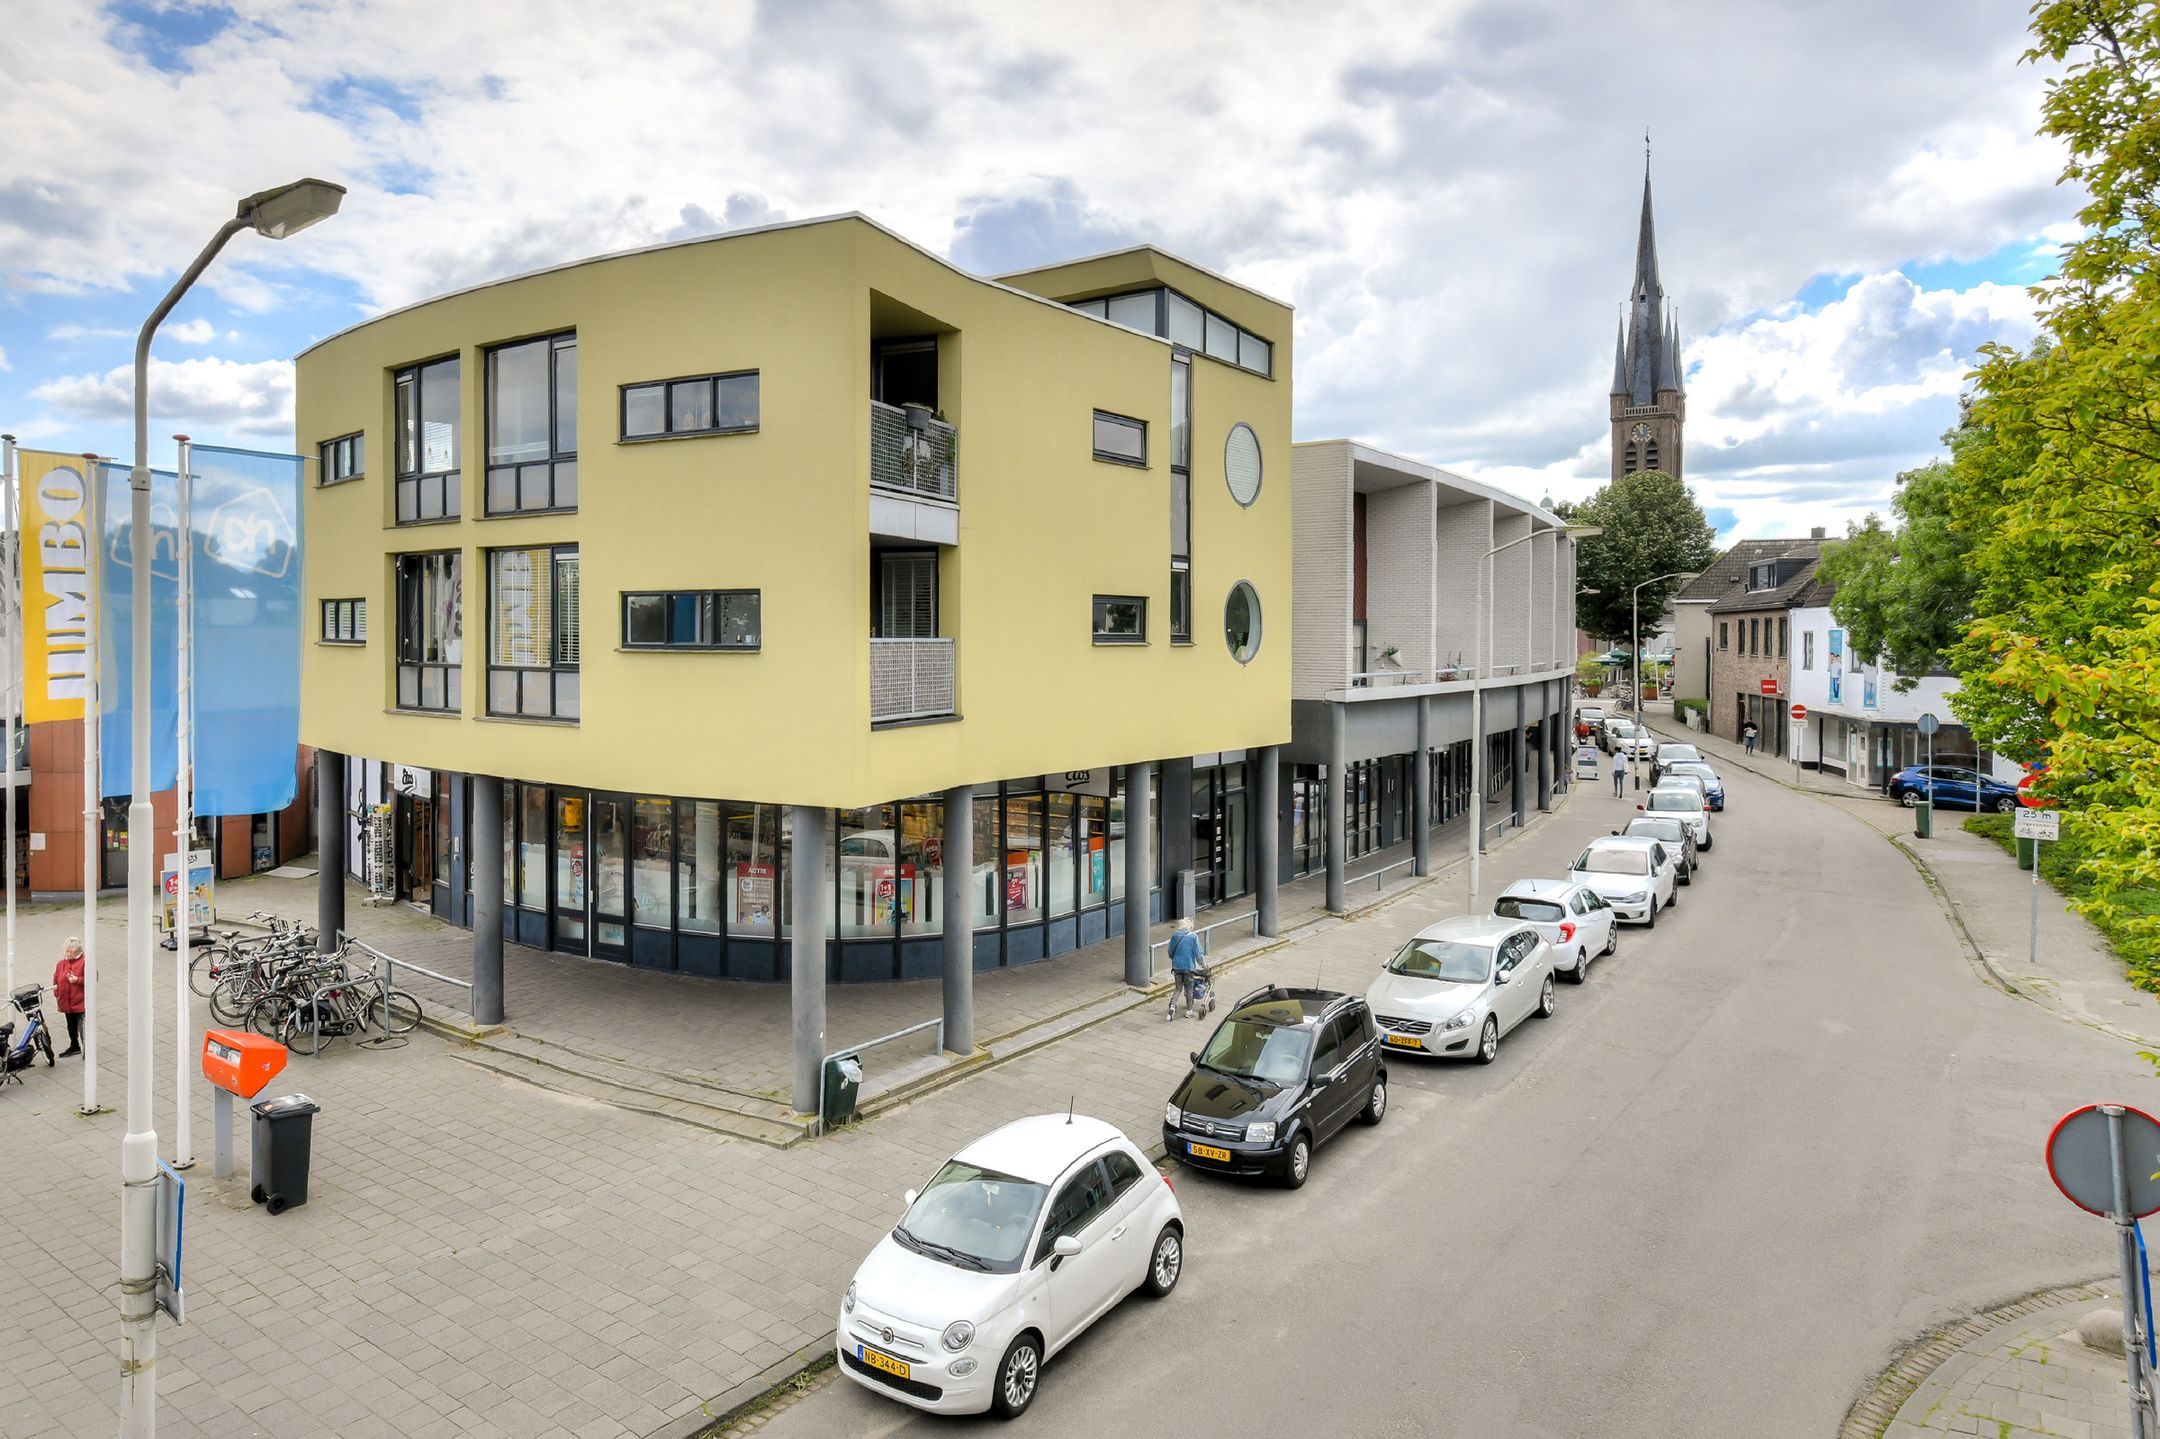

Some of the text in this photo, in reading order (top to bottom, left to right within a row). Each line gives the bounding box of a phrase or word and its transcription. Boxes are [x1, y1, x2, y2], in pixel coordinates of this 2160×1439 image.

[2023, 810, 2037, 818] 25
[1193, 1145, 1227, 1159] 58-XV-ZR
[864, 1350, 906, 1375] NB-344-D
